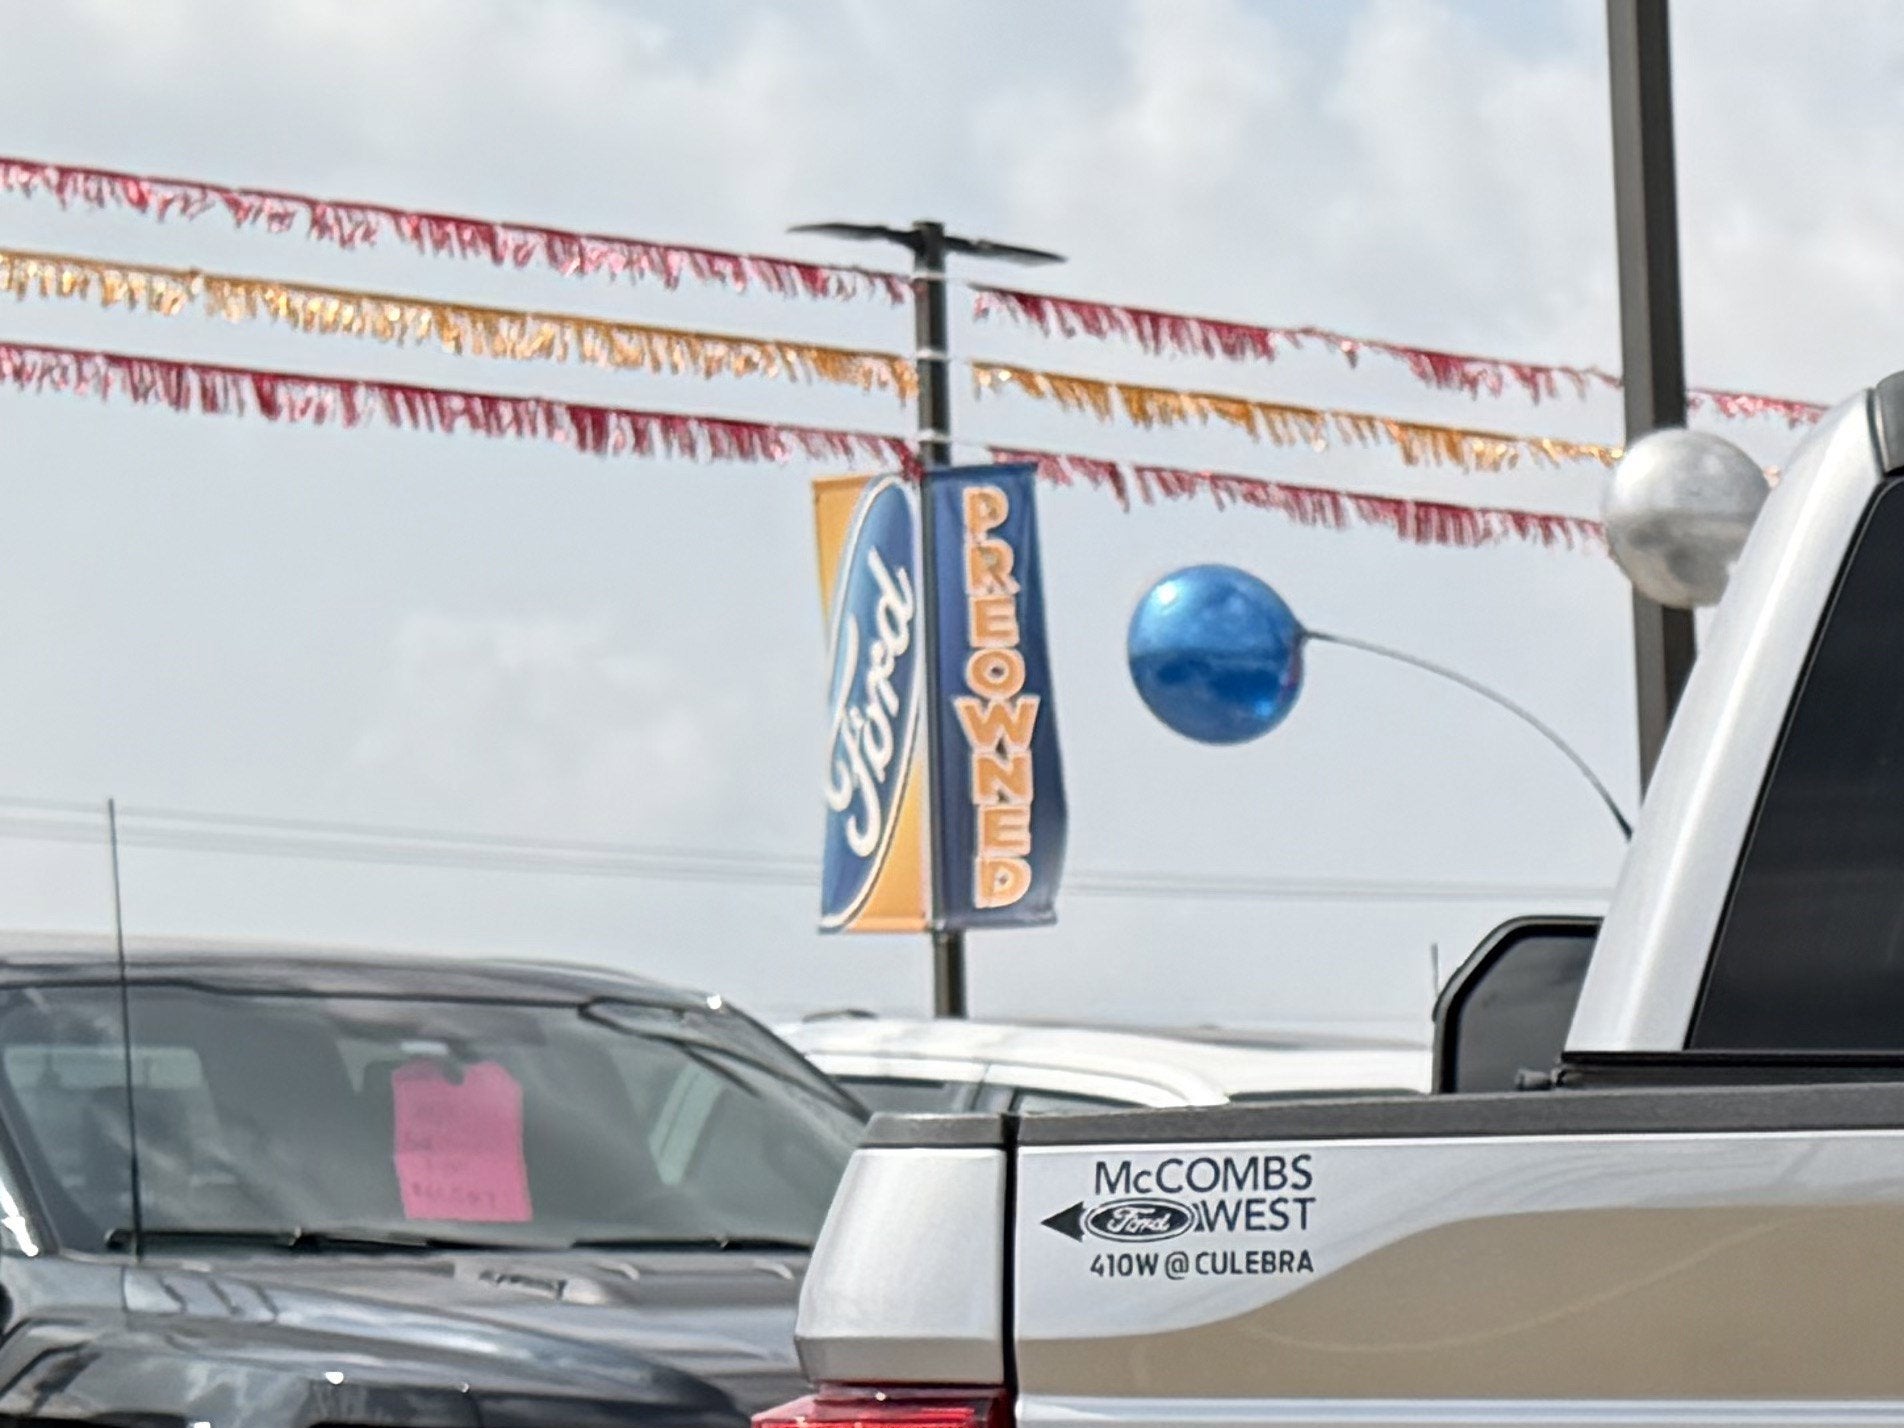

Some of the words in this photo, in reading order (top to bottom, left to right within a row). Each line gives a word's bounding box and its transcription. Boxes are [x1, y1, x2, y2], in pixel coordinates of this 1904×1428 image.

[824, 545, 915, 857] Ford
[953, 485, 1040, 908] PREOWNED
[1095, 1154, 1314, 1195] McCOMBS
[1106, 1207, 1172, 1233] Ford
[1201, 1197, 1317, 1232] WEST
[1090, 1254, 1158, 1277] 410W
[1165, 1251, 1189, 1280] @
[1196, 1250, 1315, 1275] CULEBRA
